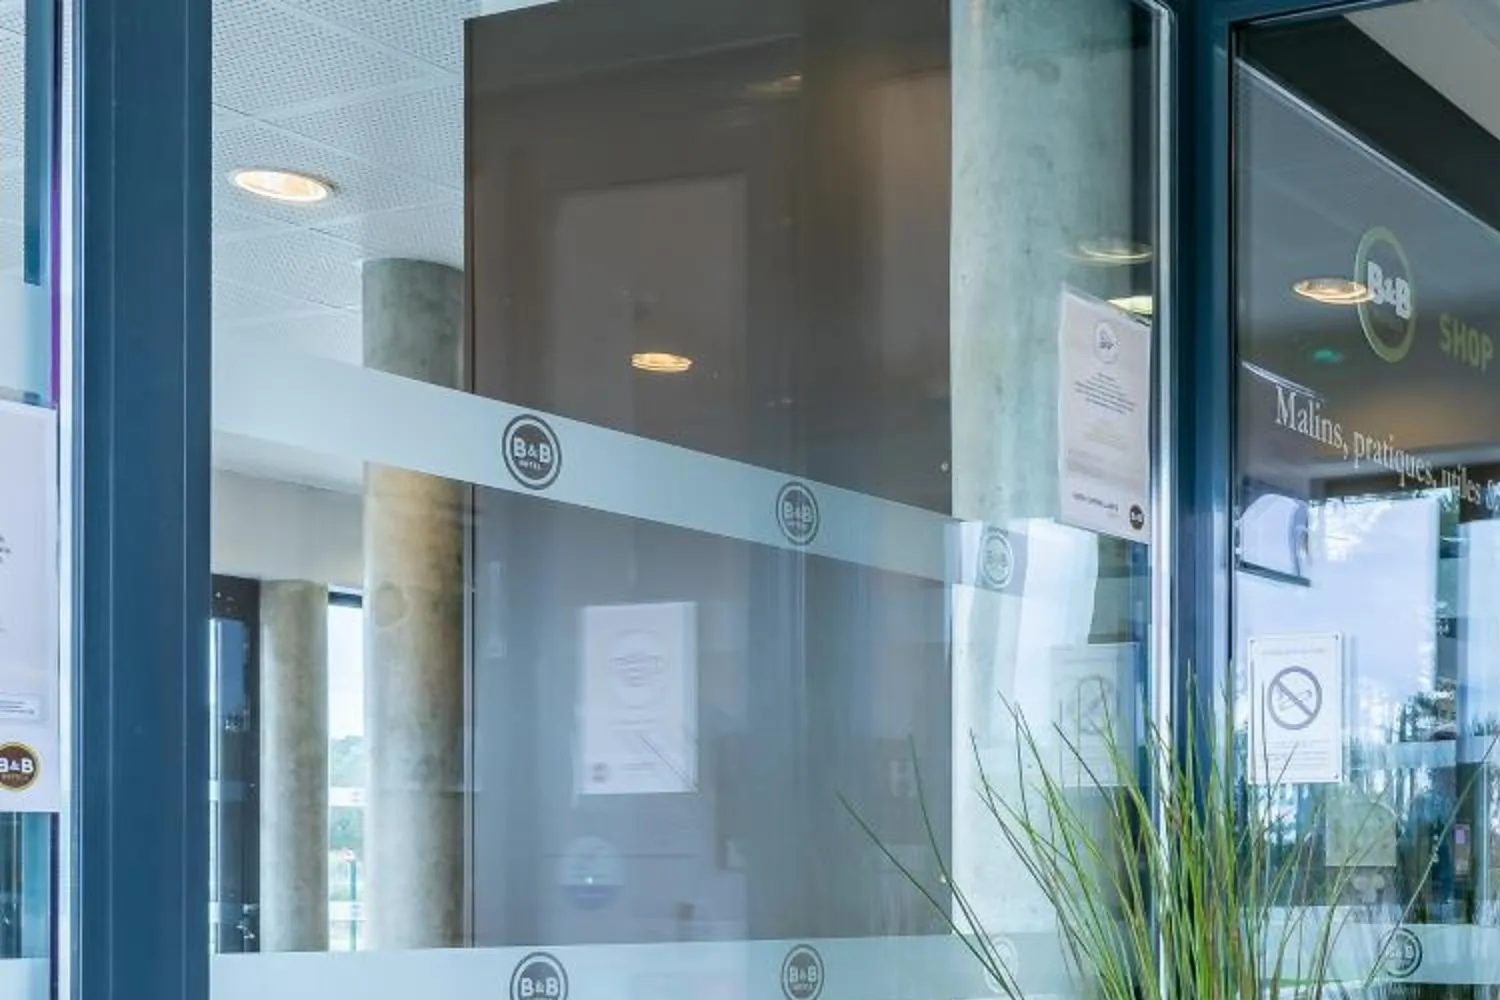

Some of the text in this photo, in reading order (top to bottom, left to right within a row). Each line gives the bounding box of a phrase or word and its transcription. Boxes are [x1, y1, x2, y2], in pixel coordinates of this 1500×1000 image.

[1439, 313, 1494, 373] SHOP
[512, 437, 551, 463] B&B
[1275, 384, 1349, 460] Malins,
